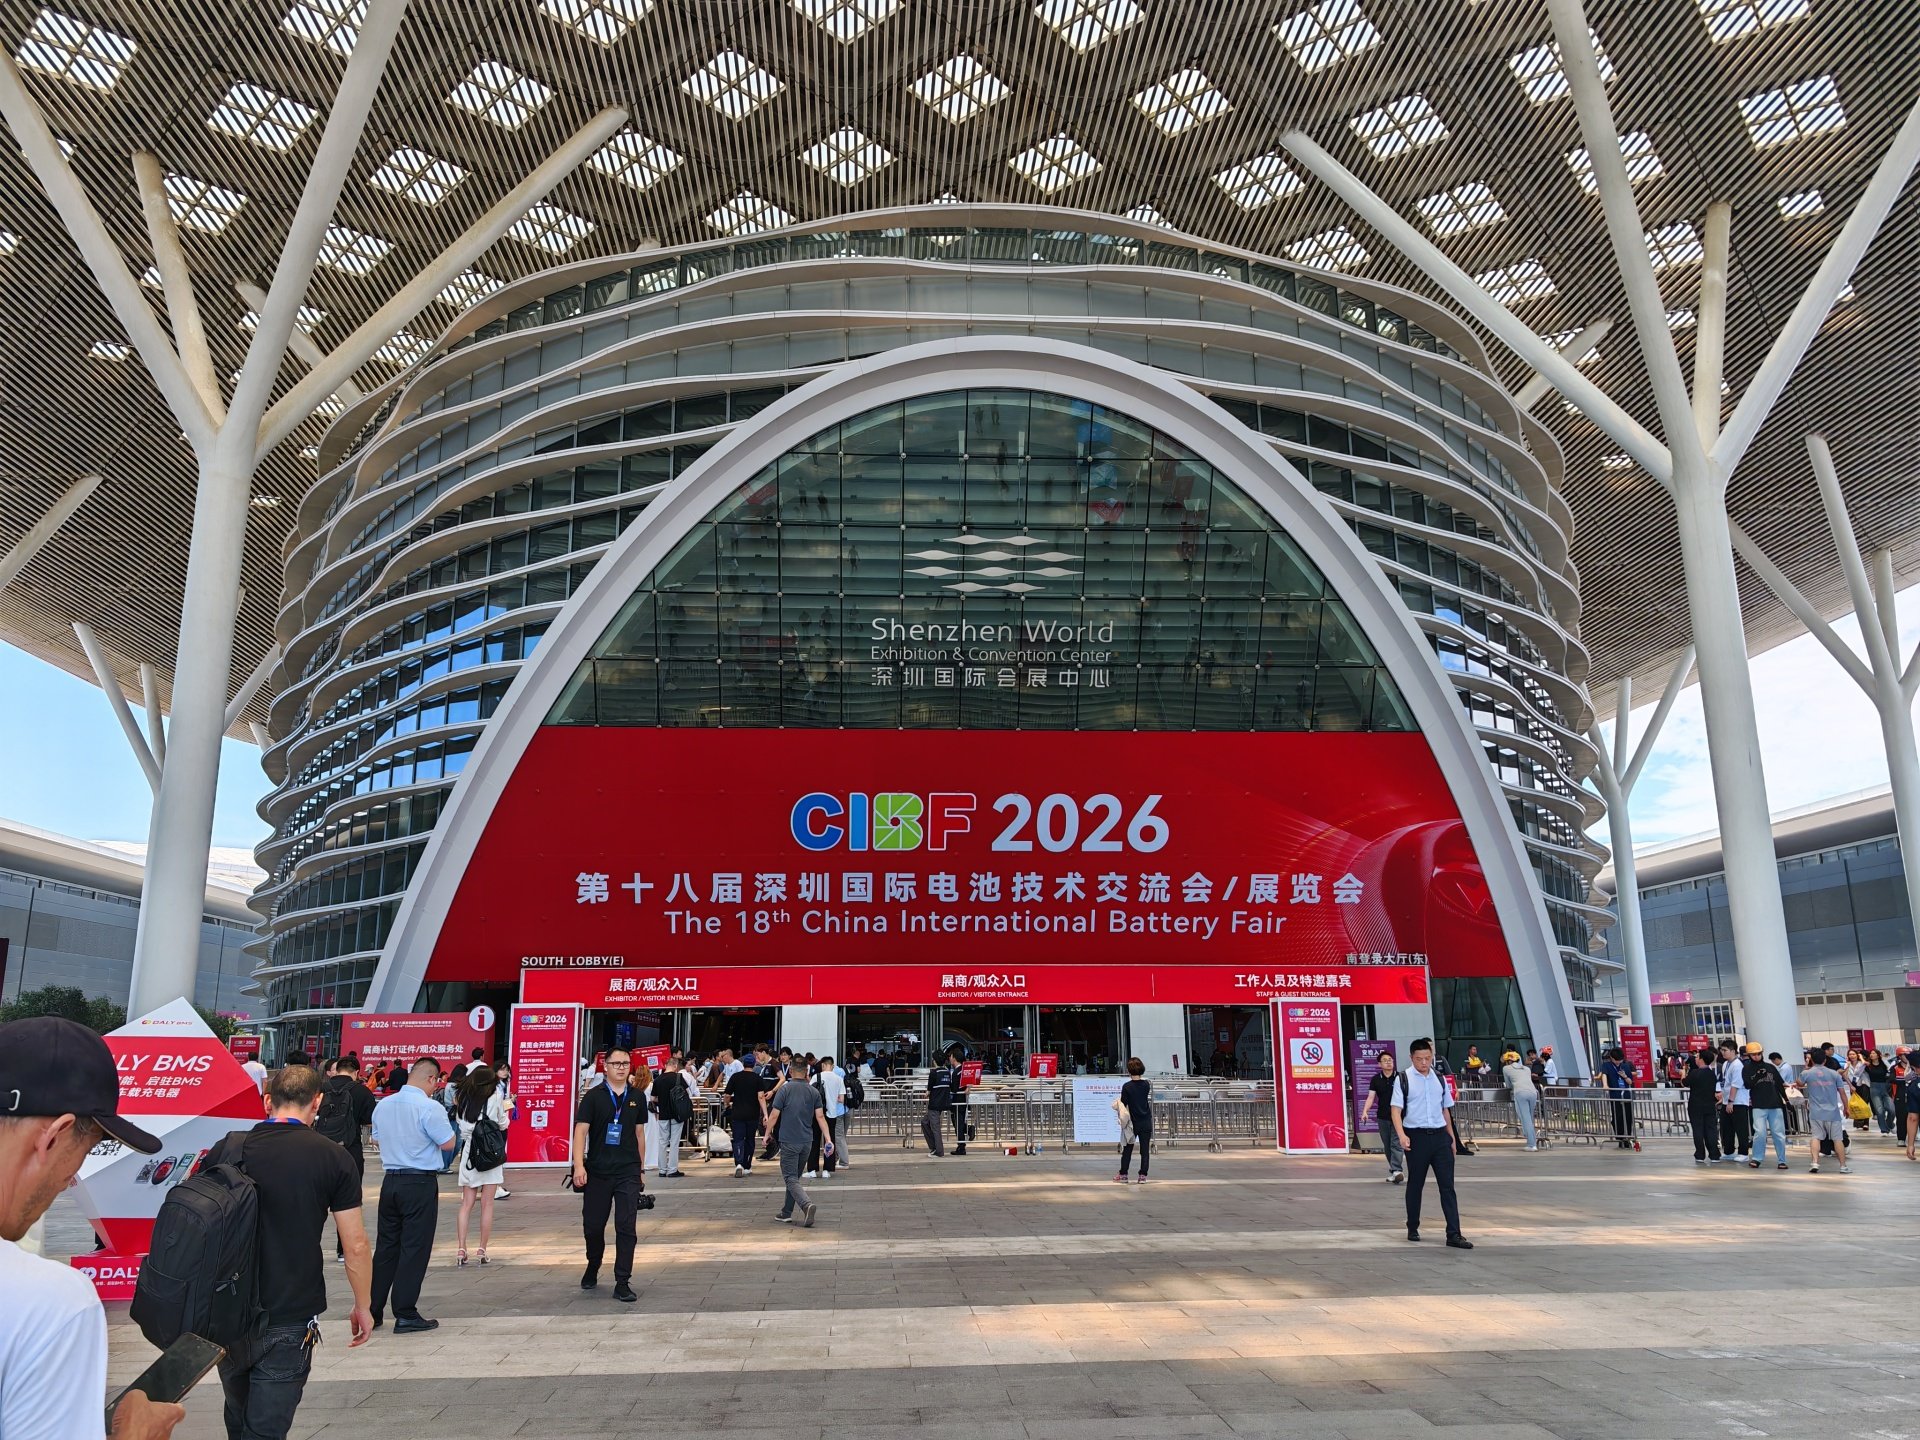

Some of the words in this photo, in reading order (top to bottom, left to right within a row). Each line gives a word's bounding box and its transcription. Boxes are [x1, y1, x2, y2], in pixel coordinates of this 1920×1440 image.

[871, 617, 1012, 642] Shenzhen
[1024, 619, 1114, 643] World
[871, 646, 947, 661] Exhibition
[952, 646, 965, 661] &
[968, 646, 1056, 662] Convention
[1060, 648, 1112, 662] Center
[871, 667, 1111, 688] 深圳国际会展中心
[790, 792, 977, 851] CIBF
[991, 793, 1170, 853] 2026
[575, 871, 1366, 904] 第十八届深圳国际电池技术交流会/展览会
[663, 910, 722, 934] The
[735, 909, 791, 934] 18th
[801, 909, 888, 934] China
[901, 909, 1096, 934] International
[1109, 910, 1219, 940] Battery
[1231, 910, 1287, 934] Fair
[521, 956, 563, 966] SOUTH
[569, 955, 625, 967] LOBBY(E)
[1346, 953, 1429, 965] 南登录大厅(东)
[609, 977, 697, 992] 展商/观众入口
[941, 974, 1026, 988] 展商/观众入口
[1234, 974, 1352, 988] 工作人员及特邀嘉宾
[545, 1015, 567, 1023] 2026
[1310, 1008, 1331, 1017] 2026
[362, 1044, 464, 1055] 展商补打证件/观众服务处
[520, 1041, 565, 1049] 展览会开放时间
[1305, 1047, 1320, 1060] 18
[152, 1055, 214, 1072] BMS
[525, 1099, 546, 1108] 3-16
